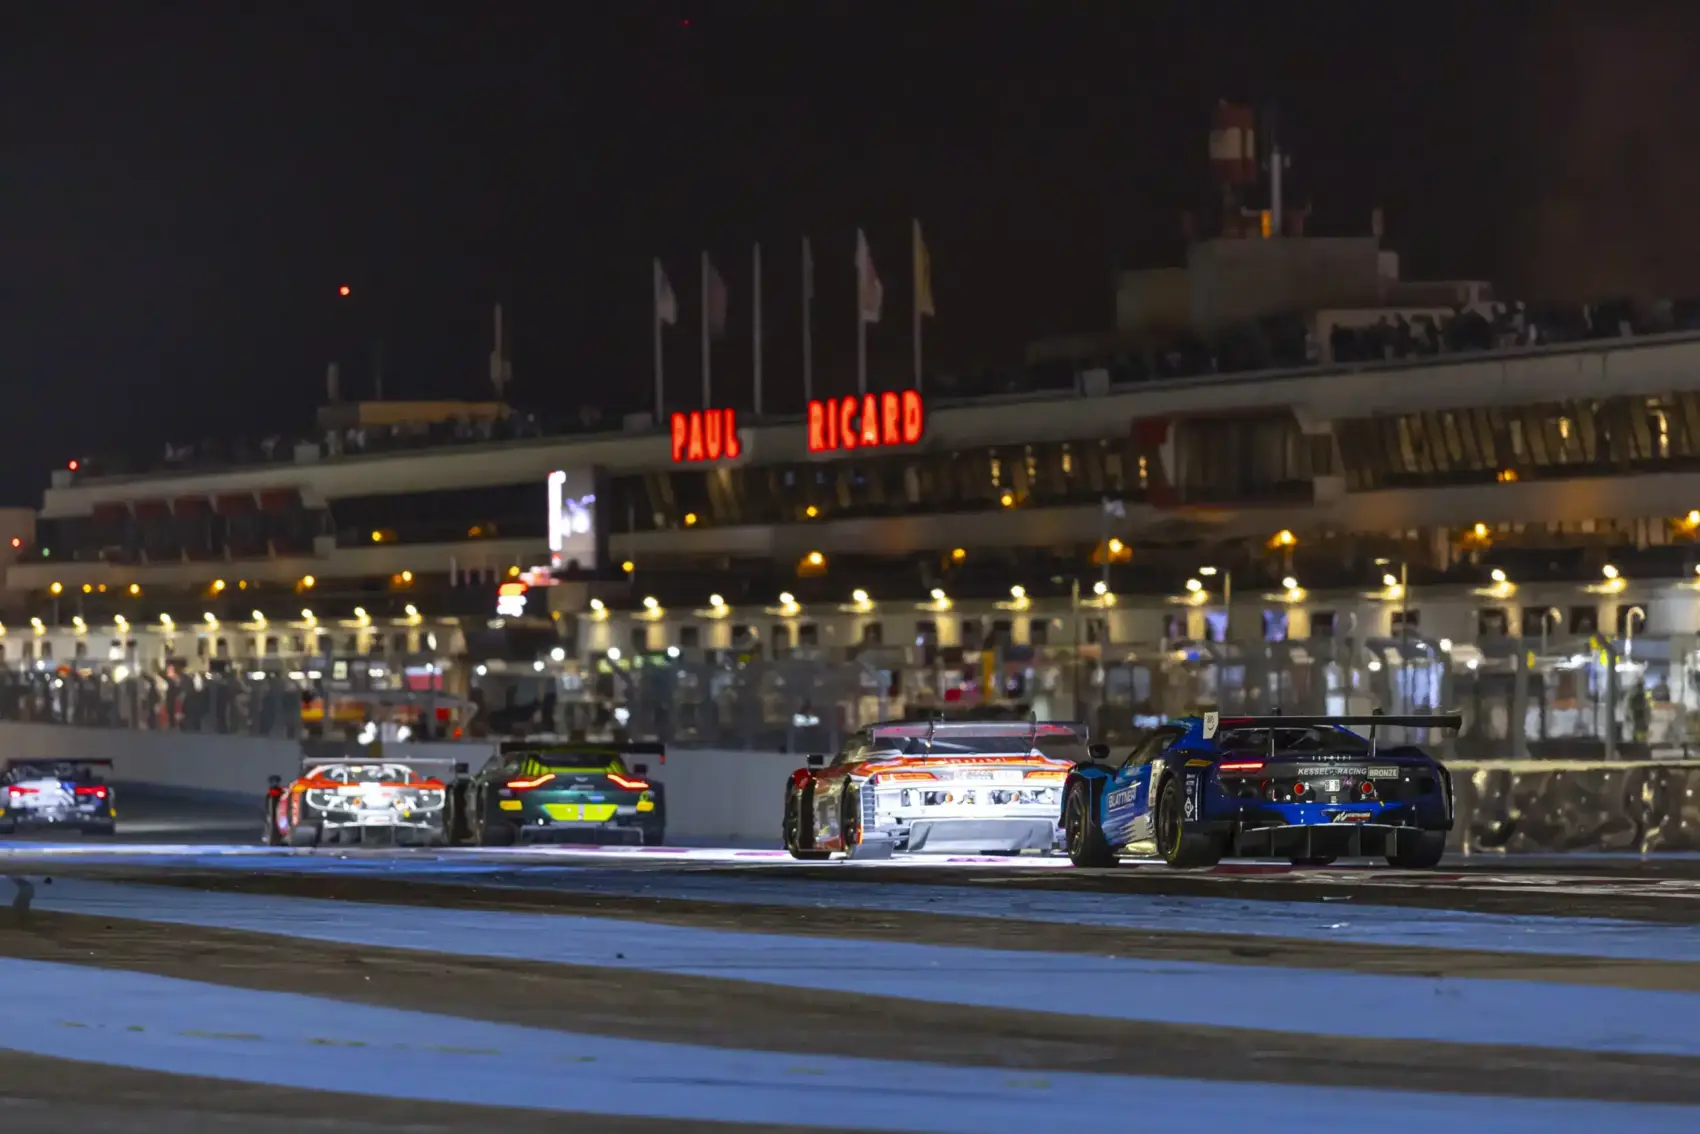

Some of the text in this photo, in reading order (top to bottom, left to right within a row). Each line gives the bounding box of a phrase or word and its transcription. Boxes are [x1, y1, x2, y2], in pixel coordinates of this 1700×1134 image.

[671, 389, 924, 462] PAUL RICARD
[1297, 767, 1367, 776] KESSEL RACING
[1369, 769, 1397, 777] BRONZE
